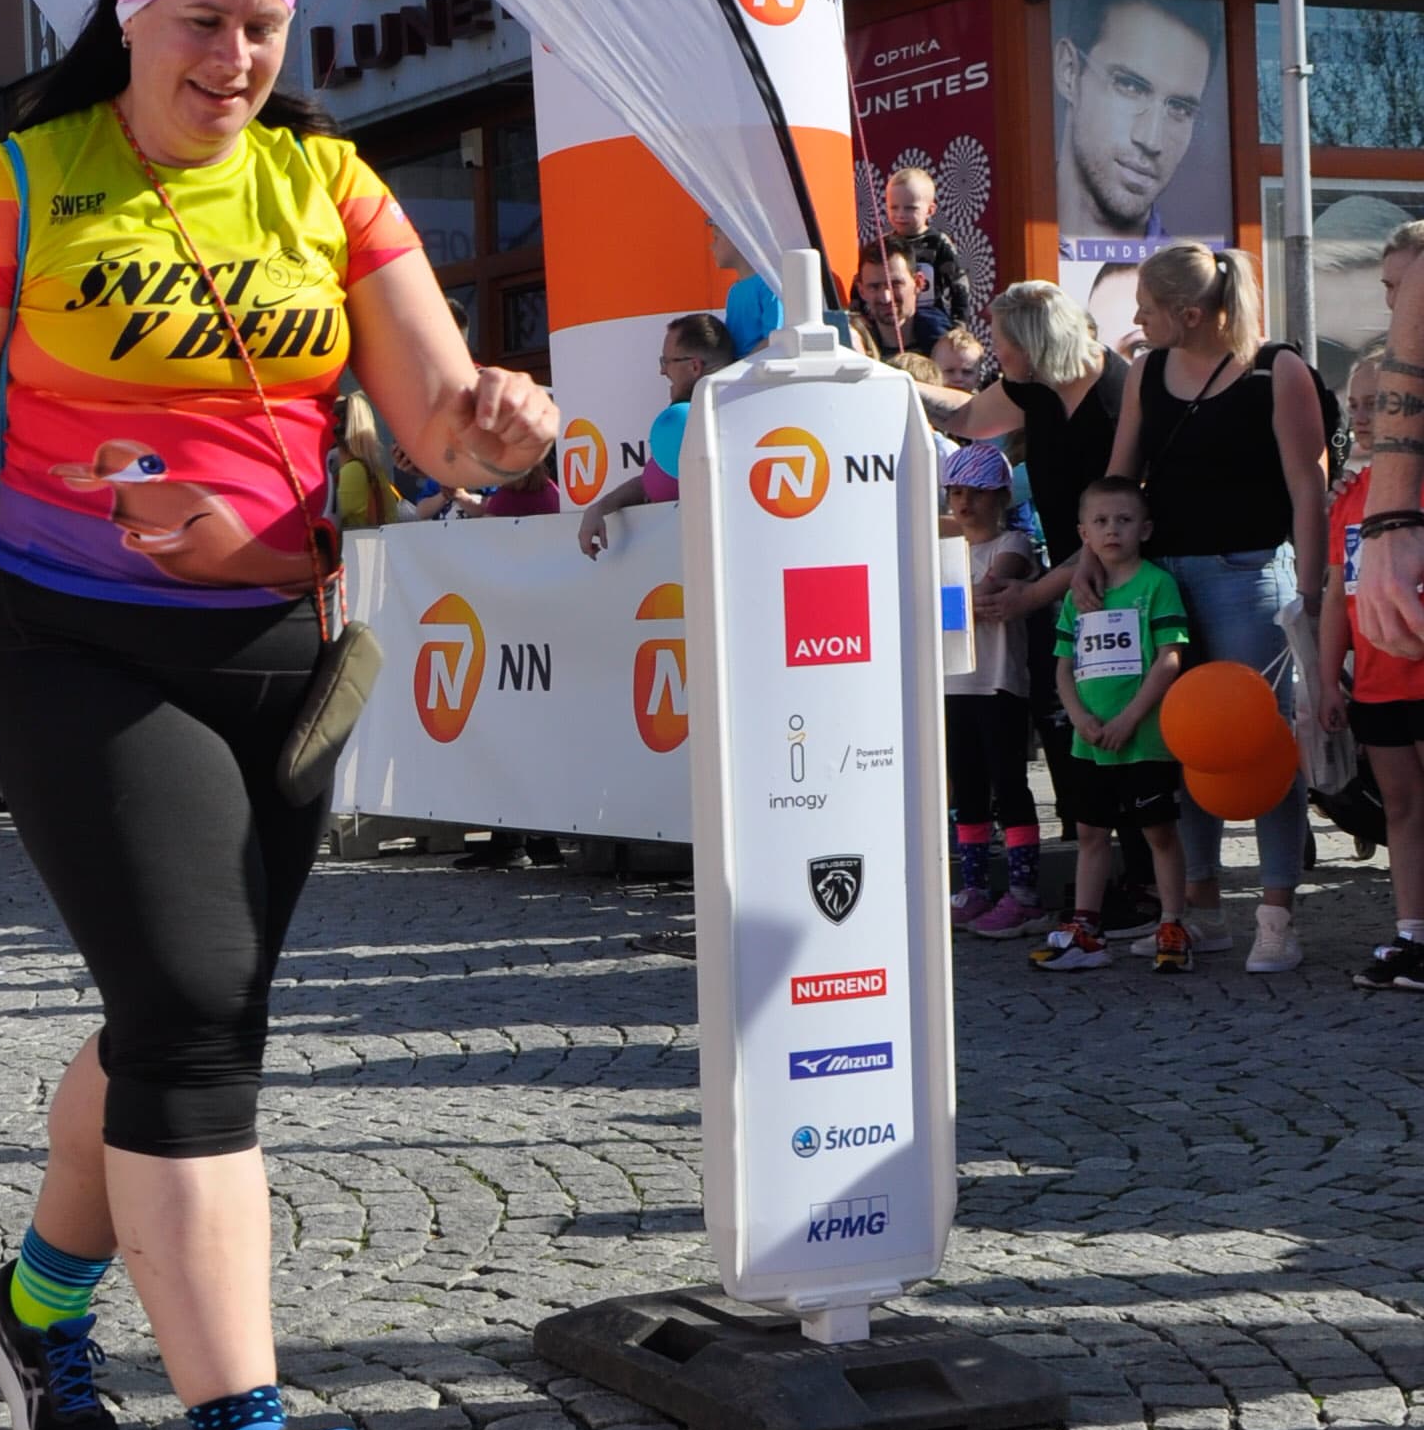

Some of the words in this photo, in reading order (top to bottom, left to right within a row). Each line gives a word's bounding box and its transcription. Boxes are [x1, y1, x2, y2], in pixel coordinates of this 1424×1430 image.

[874, 38, 941, 67] OPTIKA
[857, 61, 989, 119] UNETTES
[50, 191, 107, 217] SWEEP
[109, 310, 171, 361] V
[846, 454, 896, 484] NN
[794, 635, 863, 658] AVON
[1084, 632, 1132, 653] 3156
[498, 643, 552, 692] NN
[855, 745, 895, 758] Powered
[855, 759, 869, 772] by
[870, 756, 895, 768] MVM
[769, 791, 828, 811] innogy
[812, 859, 859, 871] PEUGEOT
[796, 975, 884, 1000] NUTREND
[824, 1123, 896, 1151] ŠKODA
[807, 1211, 886, 1244] KPMG
